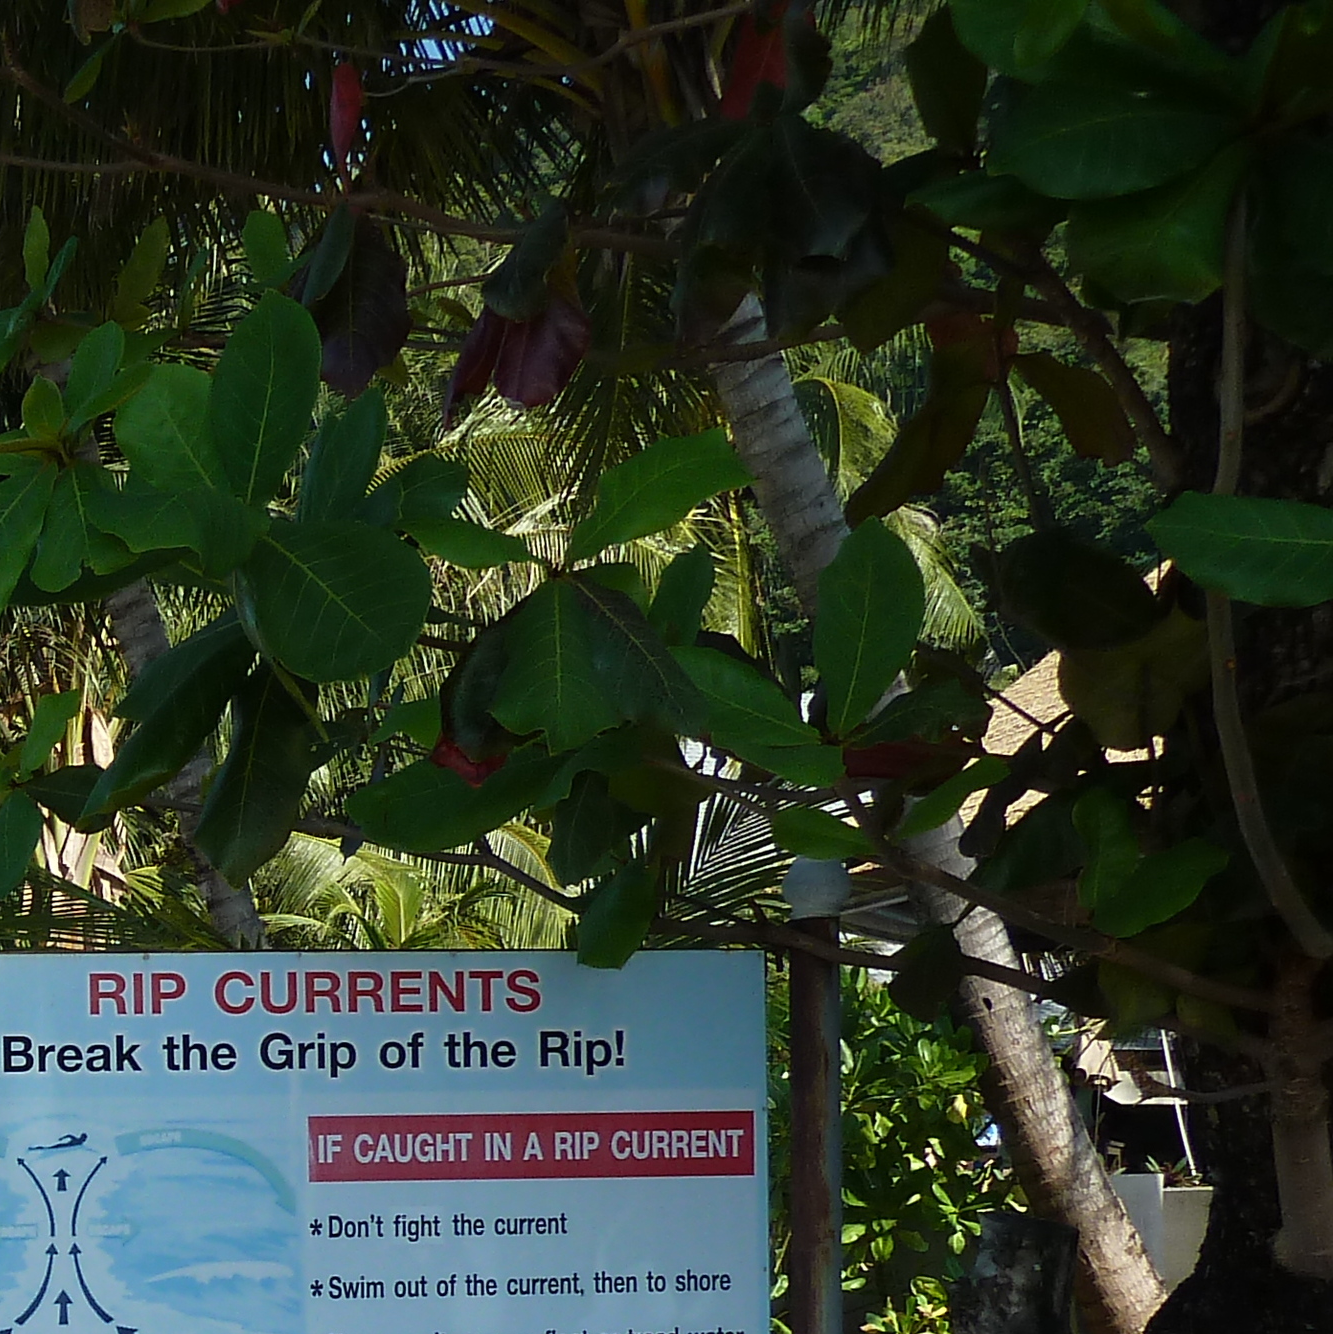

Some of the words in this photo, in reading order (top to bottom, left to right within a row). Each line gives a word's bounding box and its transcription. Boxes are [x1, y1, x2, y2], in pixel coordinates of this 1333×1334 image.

[90, 973, 186, 1015] RIP
[215, 970, 541, 1014] CURRENTS
[3, 1035, 142, 1072] Break
[163, 1035, 236, 1070] the
[260, 1033, 356, 1077] Grip
[380, 1032, 424, 1068] of
[444, 1032, 516, 1067] the
[540, 1031, 624, 1075] Rip!
[318, 1135, 342, 1163] IF
[354, 1133, 472, 1163] CAUGHT
[485, 1133, 511, 1160] IN
[523, 1132, 543, 1160] A
[555, 1132, 599, 1159] RIP
[611, 1130, 743, 1159] CURRENT
[329, 1214, 383, 1238] Don't
[393, 1215, 440, 1242] fight
[452, 1213, 484, 1236] the
[495, 1213, 567, 1235] current
[329, 1276, 384, 1299] Swim
[395, 1276, 427, 1297] out
[437, 1274, 456, 1296] of
[465, 1274, 497, 1296] the
[507, 1273, 584, 1296] current,
[593, 1271, 637, 1293] then
[646, 1271, 666, 1292] to
[676, 1269, 731, 1291] shore
